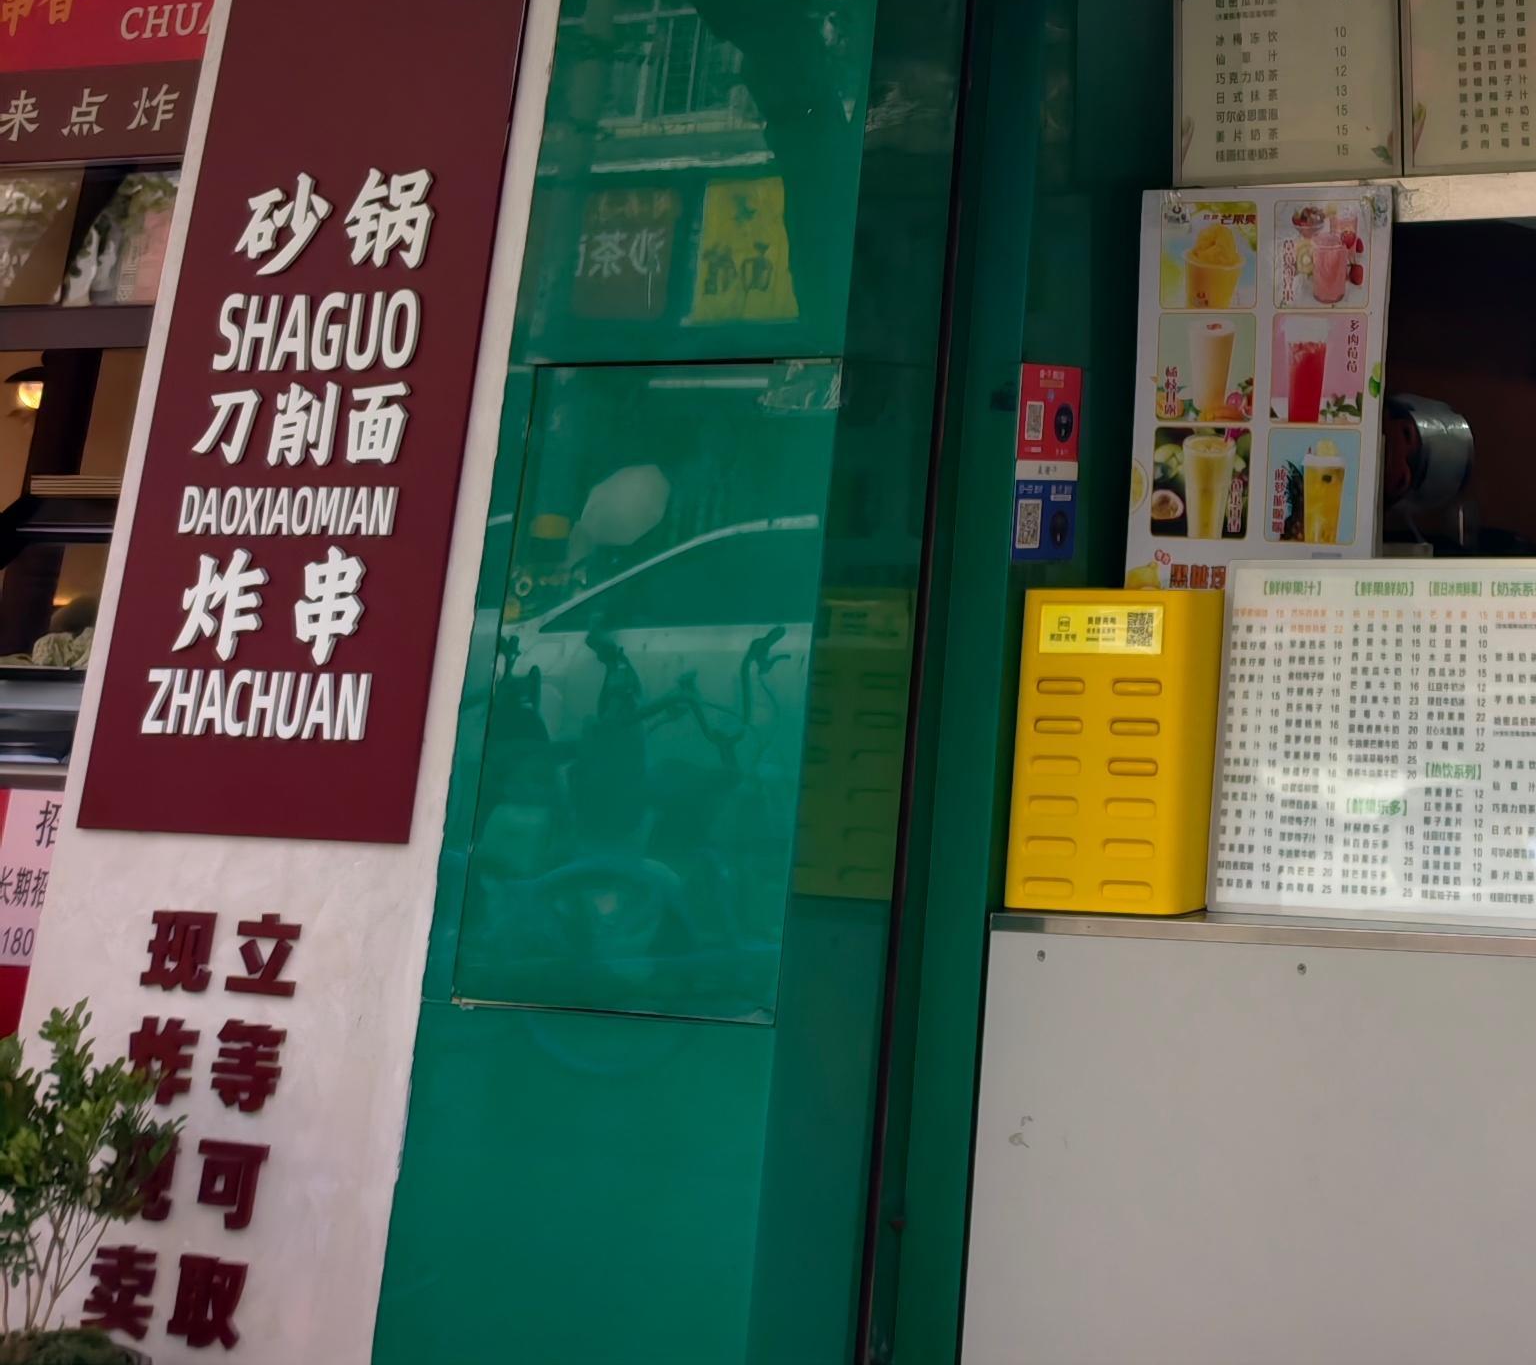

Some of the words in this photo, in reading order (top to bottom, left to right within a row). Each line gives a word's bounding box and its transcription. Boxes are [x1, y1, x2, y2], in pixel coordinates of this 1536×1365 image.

[0, 84, 181, 143] 来点炸
[234, 167, 438, 277] 砂锅
[212, 289, 422, 372] SHAGUO
[192, 381, 412, 467] 刀削面
[178, 485, 400, 536] DAOXIAOMIAN
[172, 545, 368, 666] 炸串
[140, 669, 373, 741] ZHACHUAN
[166, 911, 303, 1352] 立等可取
